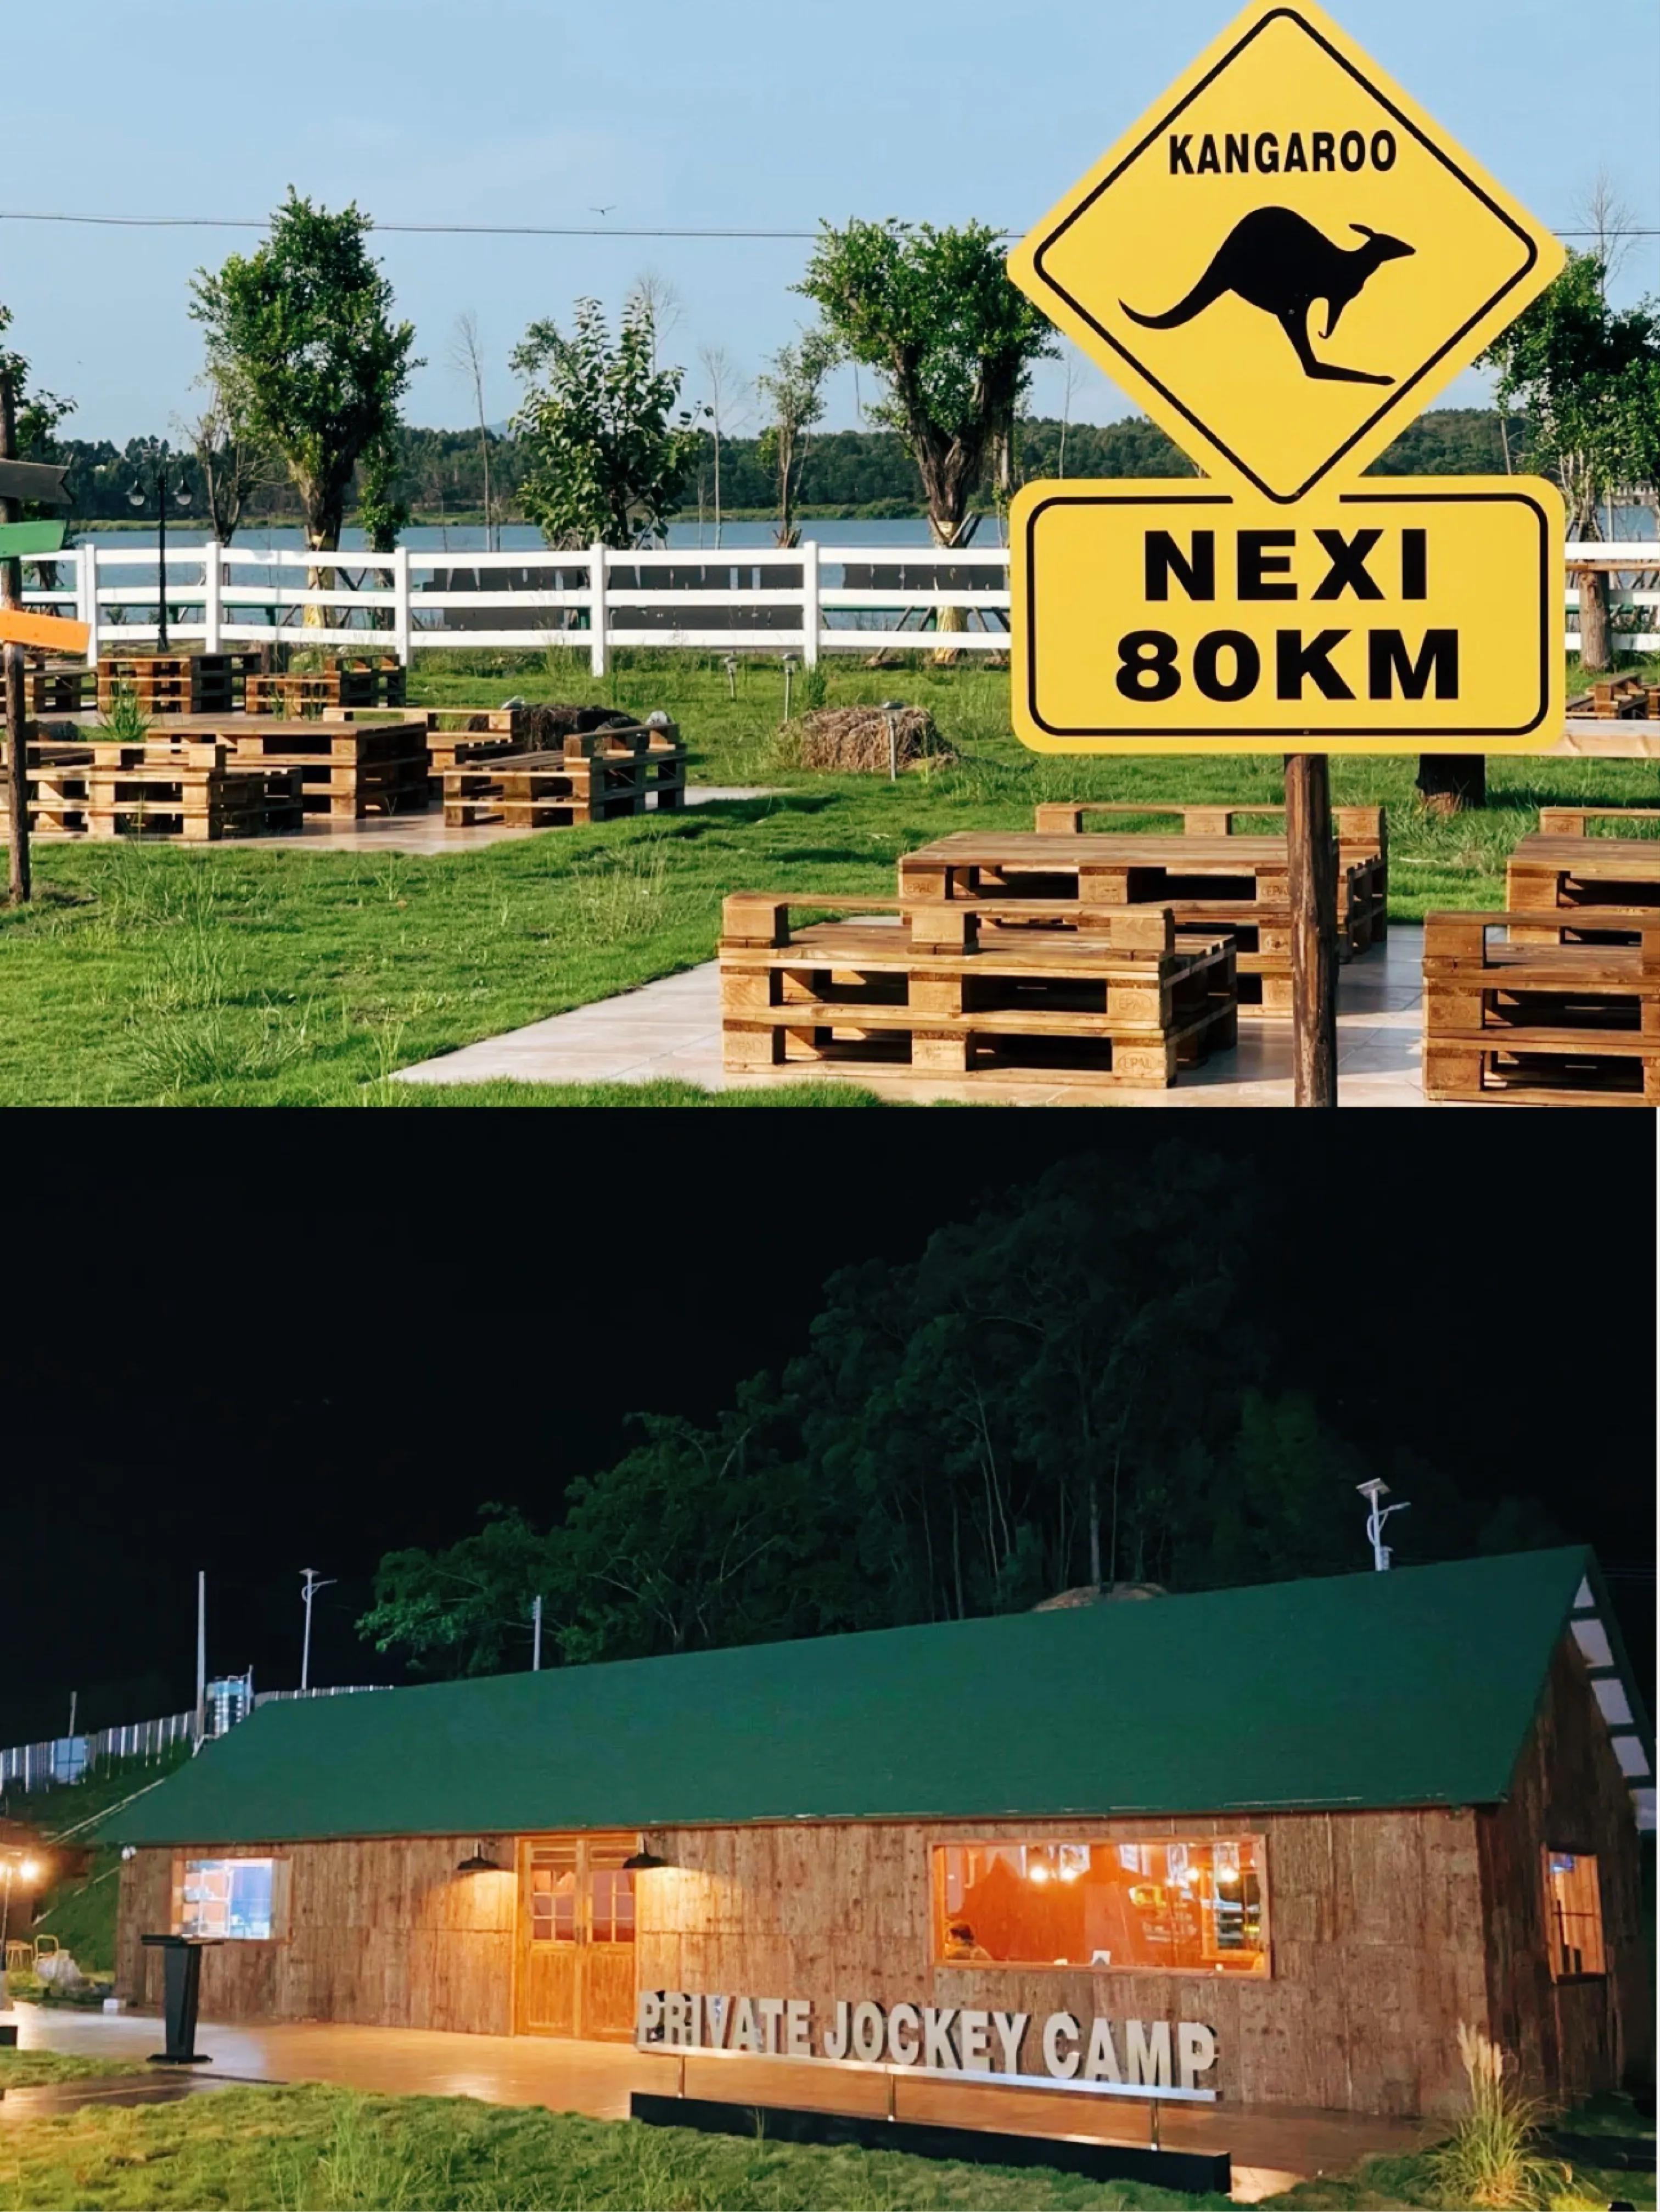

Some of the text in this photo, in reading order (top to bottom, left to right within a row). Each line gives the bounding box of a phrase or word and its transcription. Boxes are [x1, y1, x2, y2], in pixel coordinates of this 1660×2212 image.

[1170, 130, 1396, 175] KANGAROO
[1145, 529, 1426, 601] NEXI
[1117, 629, 1459, 702] 80KM
[638, 1991, 1216, 2090] PRIVATE JOCKEY CAMP
